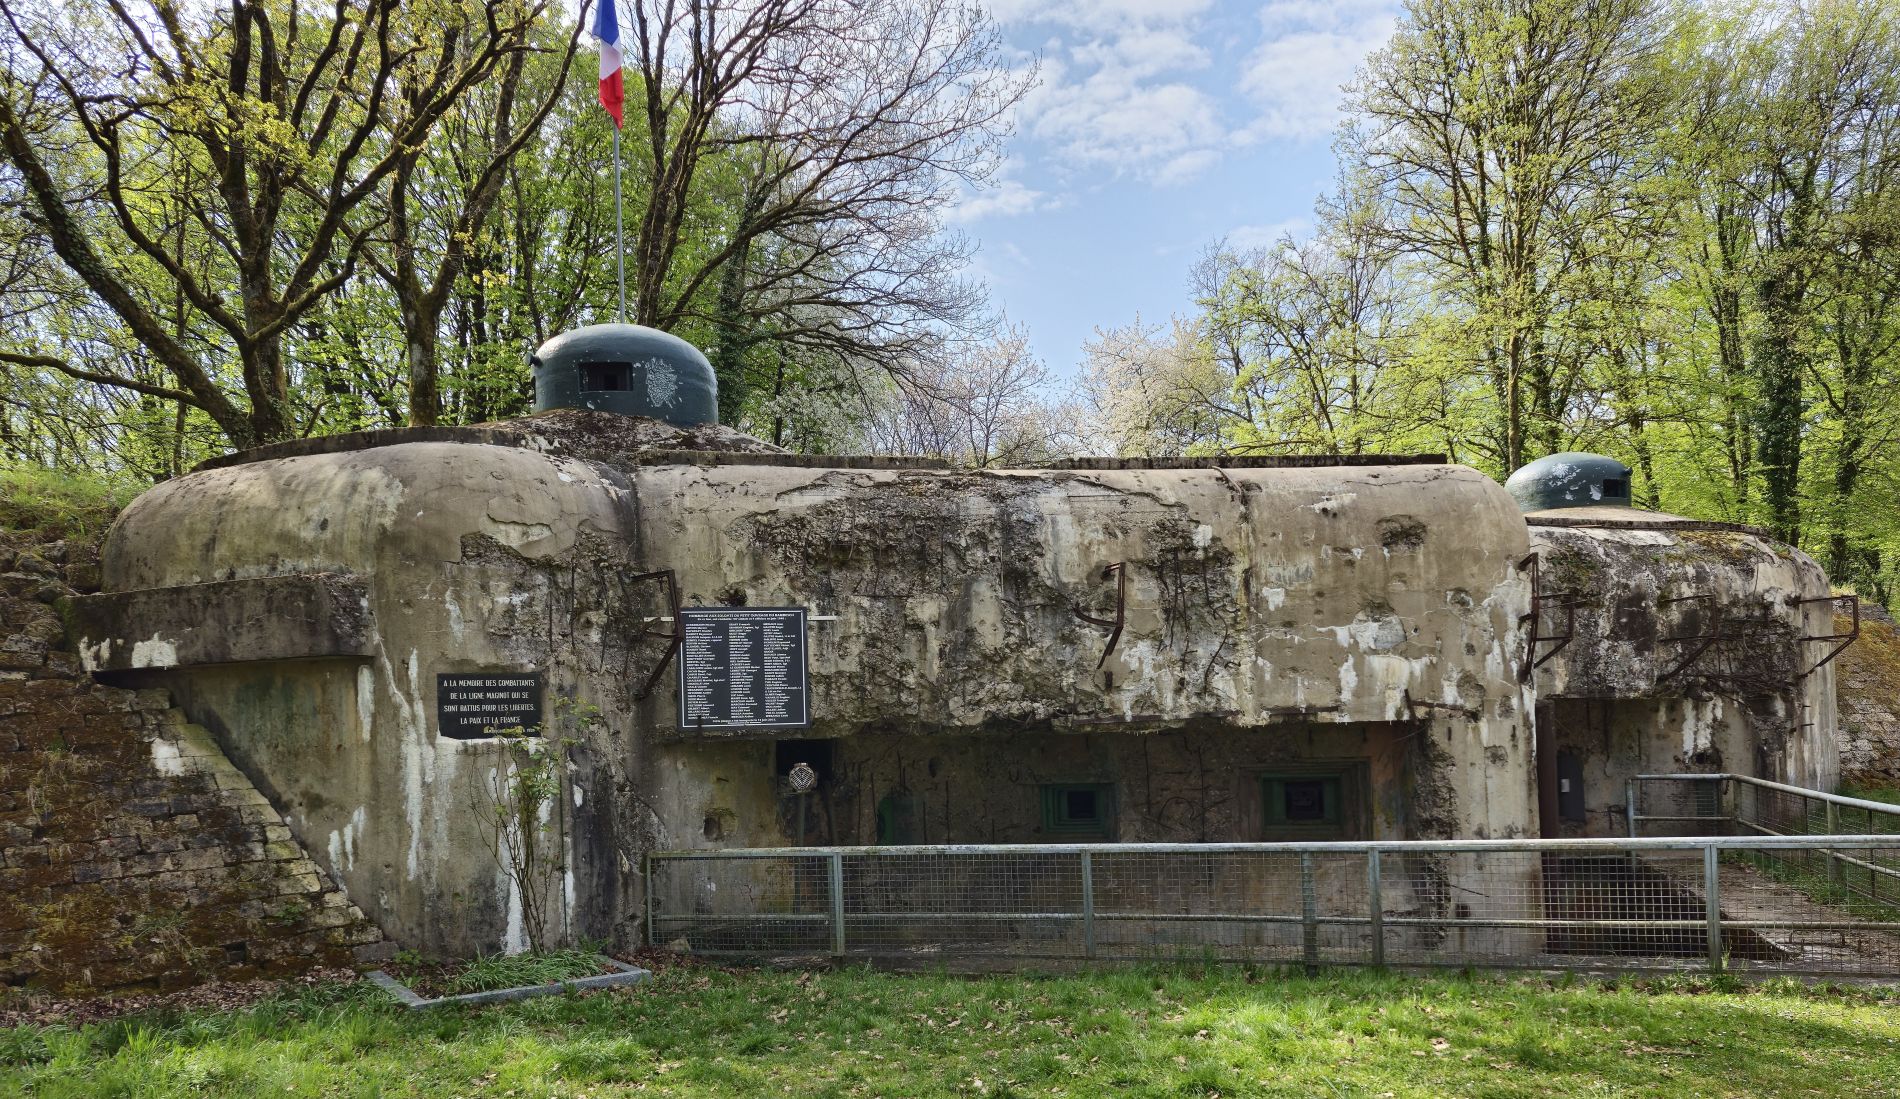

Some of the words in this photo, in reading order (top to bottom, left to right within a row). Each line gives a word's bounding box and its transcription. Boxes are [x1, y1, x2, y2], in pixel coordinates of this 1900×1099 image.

[443, 679, 448, 687] A
[449, 679, 457, 687] LA
[459, 679, 484, 687] MEMOIRE
[485, 679, 497, 687] DES
[498, 679, 535, 687] COMBATTANTS
[450, 692, 458, 700] DE
[459, 692, 467, 700] LA
[468, 692, 485, 700] LIGNE
[486, 691, 510, 699] MAGINOT
[521, 691, 529, 699] SE
[443, 704, 458, 712] SONT
[460, 704, 480, 712] BATTUS
[481, 704, 497, 712] POUR
[460, 717, 468, 725] LA
[483, 716, 490, 724] ET
[491, 716, 499, 724] LA
[500, 716, 521, 724] FRANCE
